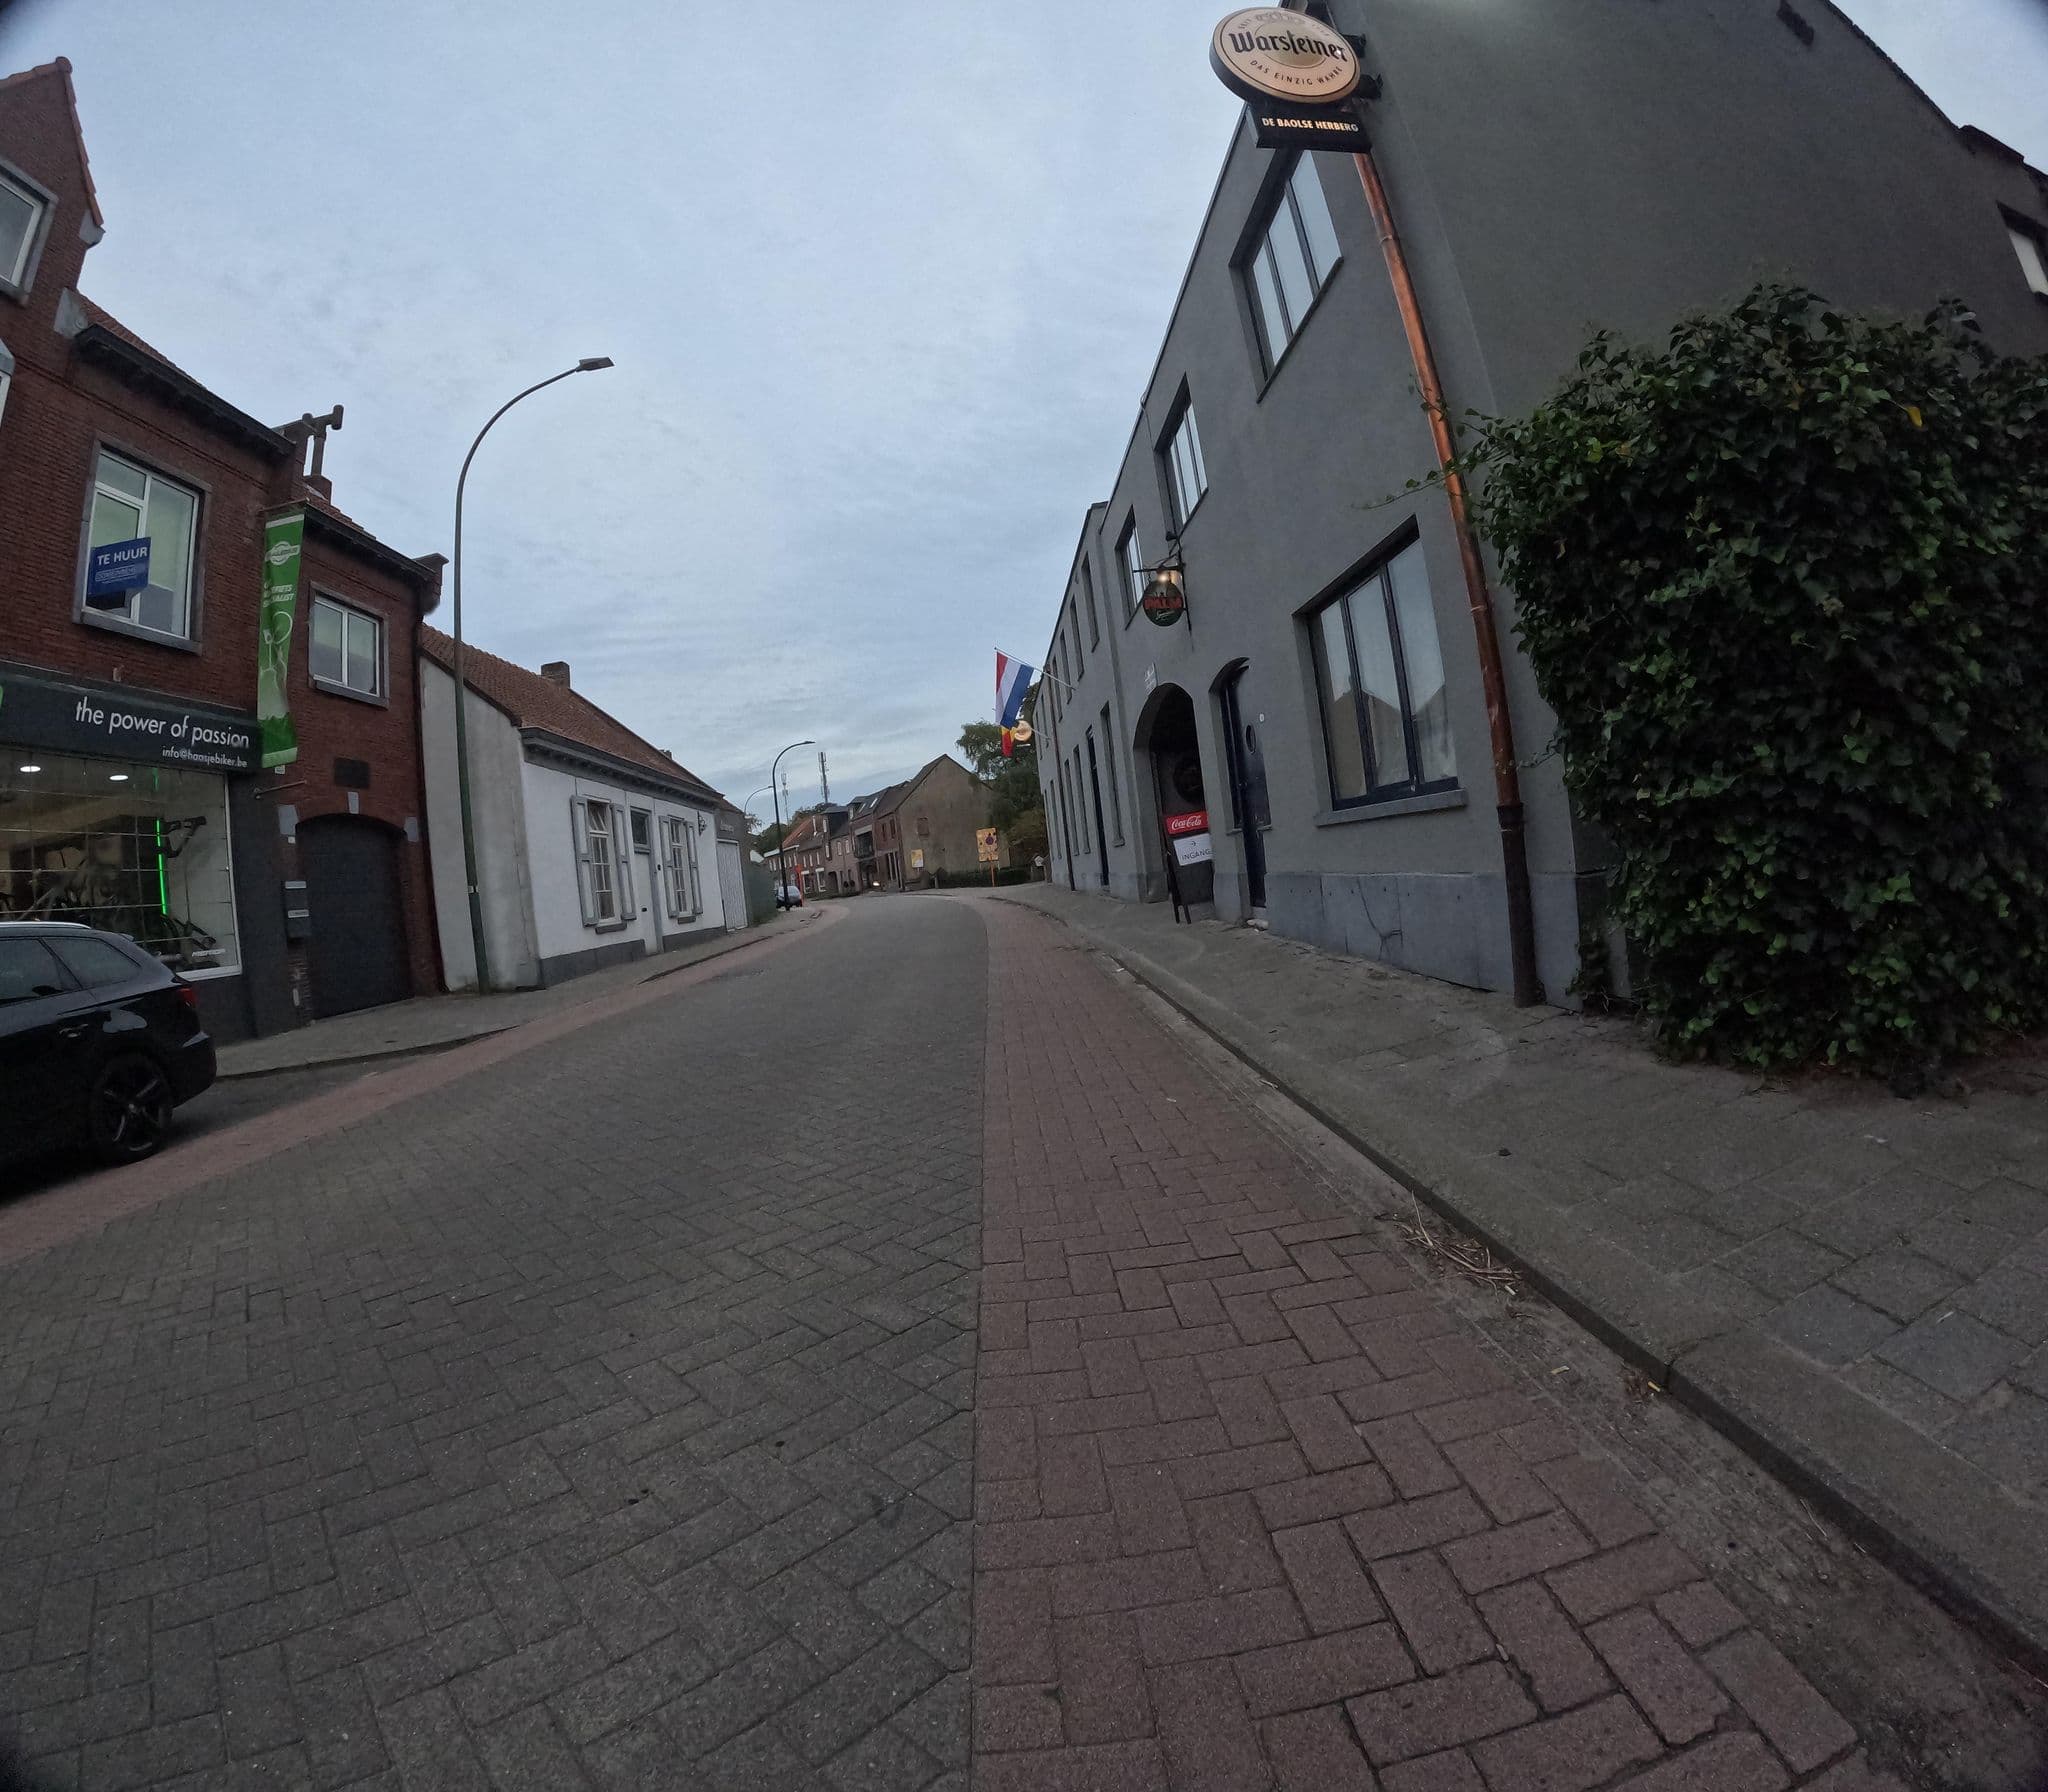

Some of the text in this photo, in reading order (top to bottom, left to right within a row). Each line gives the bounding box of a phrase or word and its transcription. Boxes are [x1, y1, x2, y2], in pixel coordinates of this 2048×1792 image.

[1228, 30, 1348, 62] Warsteiner
[1250, 60, 1343, 86] DAS EINZIG WAHRE
[1262, 118, 1359, 132] DE BAOLSE HERBERG
[97, 546, 148, 565] TE HUUR
[75, 696, 249, 748] the power of passion
